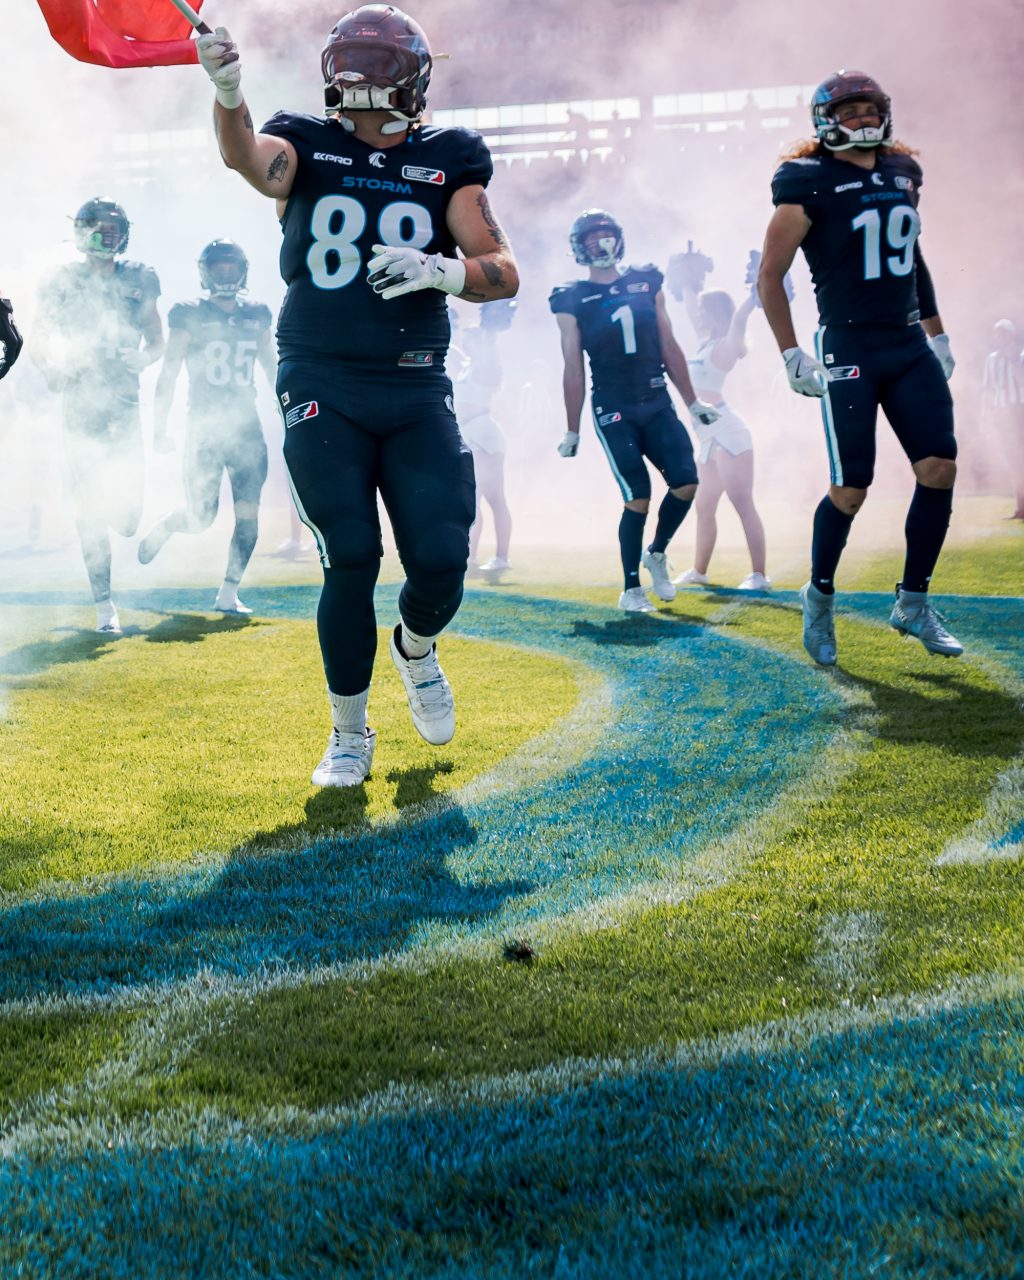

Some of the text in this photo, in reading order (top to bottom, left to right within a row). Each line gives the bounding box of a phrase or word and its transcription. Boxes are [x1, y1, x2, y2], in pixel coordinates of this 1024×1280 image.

[342, 176, 412, 194] STORM
[852, 205, 921, 280] 19
[610, 304, 637, 355] 1
[204, 340, 257, 387] 85
